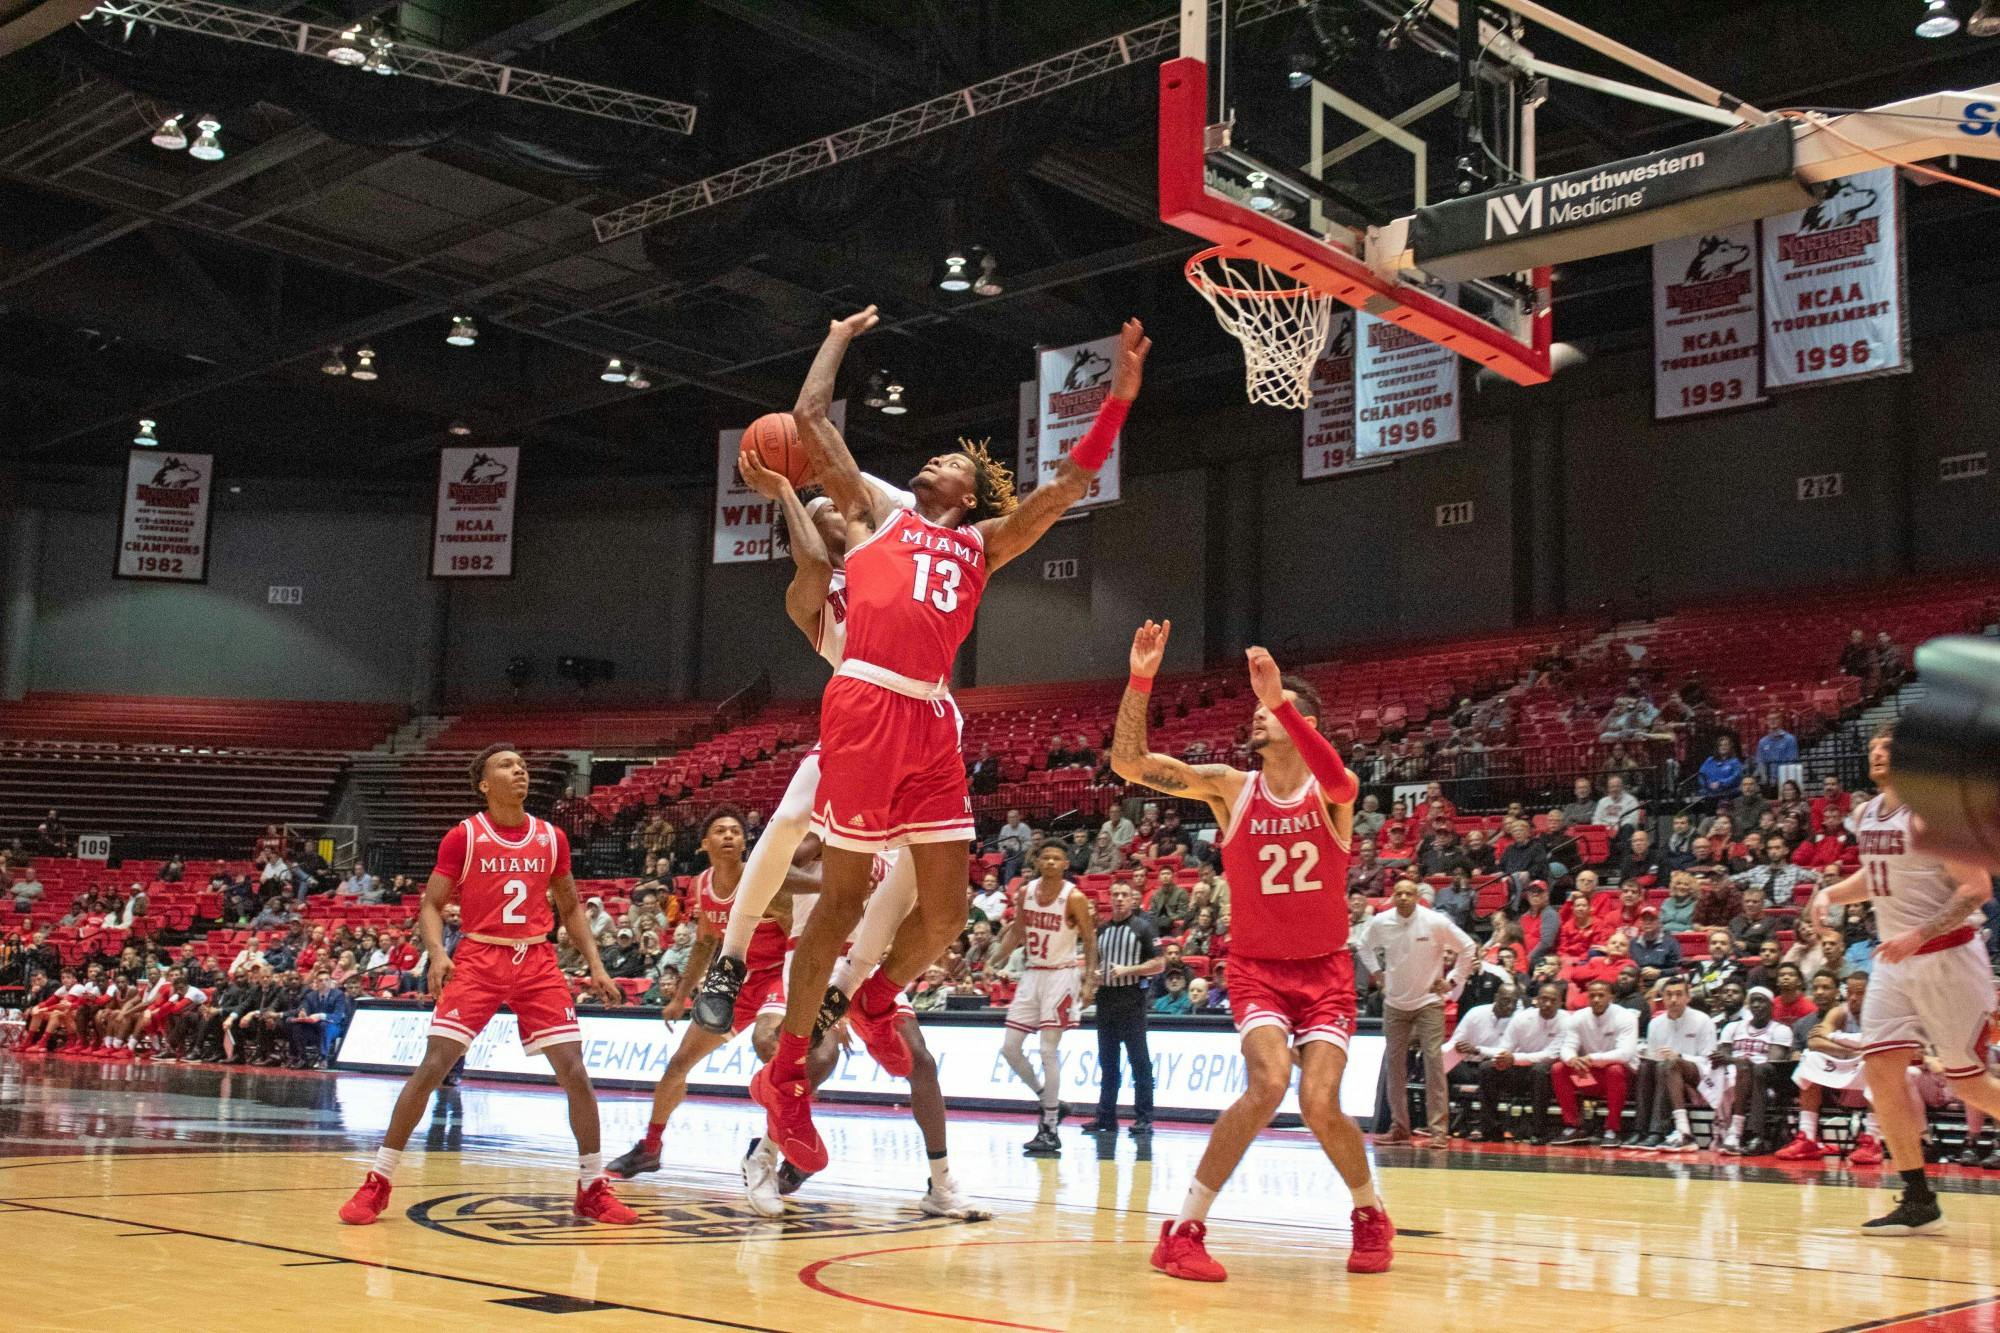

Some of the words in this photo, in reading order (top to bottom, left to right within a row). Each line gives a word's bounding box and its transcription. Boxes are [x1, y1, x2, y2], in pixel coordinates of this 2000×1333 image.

[1550, 151, 1705, 202] Northwestern
[1797, 282, 1865, 312] NCAA
[1772, 300, 1890, 334] TOURNAMENT
[1682, 328, 1738, 352] NCAA
[1796, 339, 1871, 373] 1996
[1377, 370, 1437, 389] CONFERENCE
[1681, 378, 1743, 407] 1993
[1359, 392, 1454, 422] CHAMPIONS
[1378, 416, 1438, 448] 1996
[455, 519, 495, 531] NCAA
[1441, 503, 1469, 525] 211
[124, 541, 200, 555] CHAMPIONS
[440, 533, 508, 543] TOURNAMENT
[901, 528, 981, 569] MIAMI
[137, 556, 184, 573] 1982
[451, 555, 495, 571] 1982
[1048, 560, 1075, 578] 210
[271, 588, 300, 602] 209
[911, 552, 962, 614] 13
[1249, 811, 1322, 836] MIAMI
[80, 839, 109, 856] 109
[480, 857, 546, 874] MIAMI
[1257, 840, 1324, 896] 22
[1869, 860, 1891, 897] 11
[502, 879, 528, 924] 2
